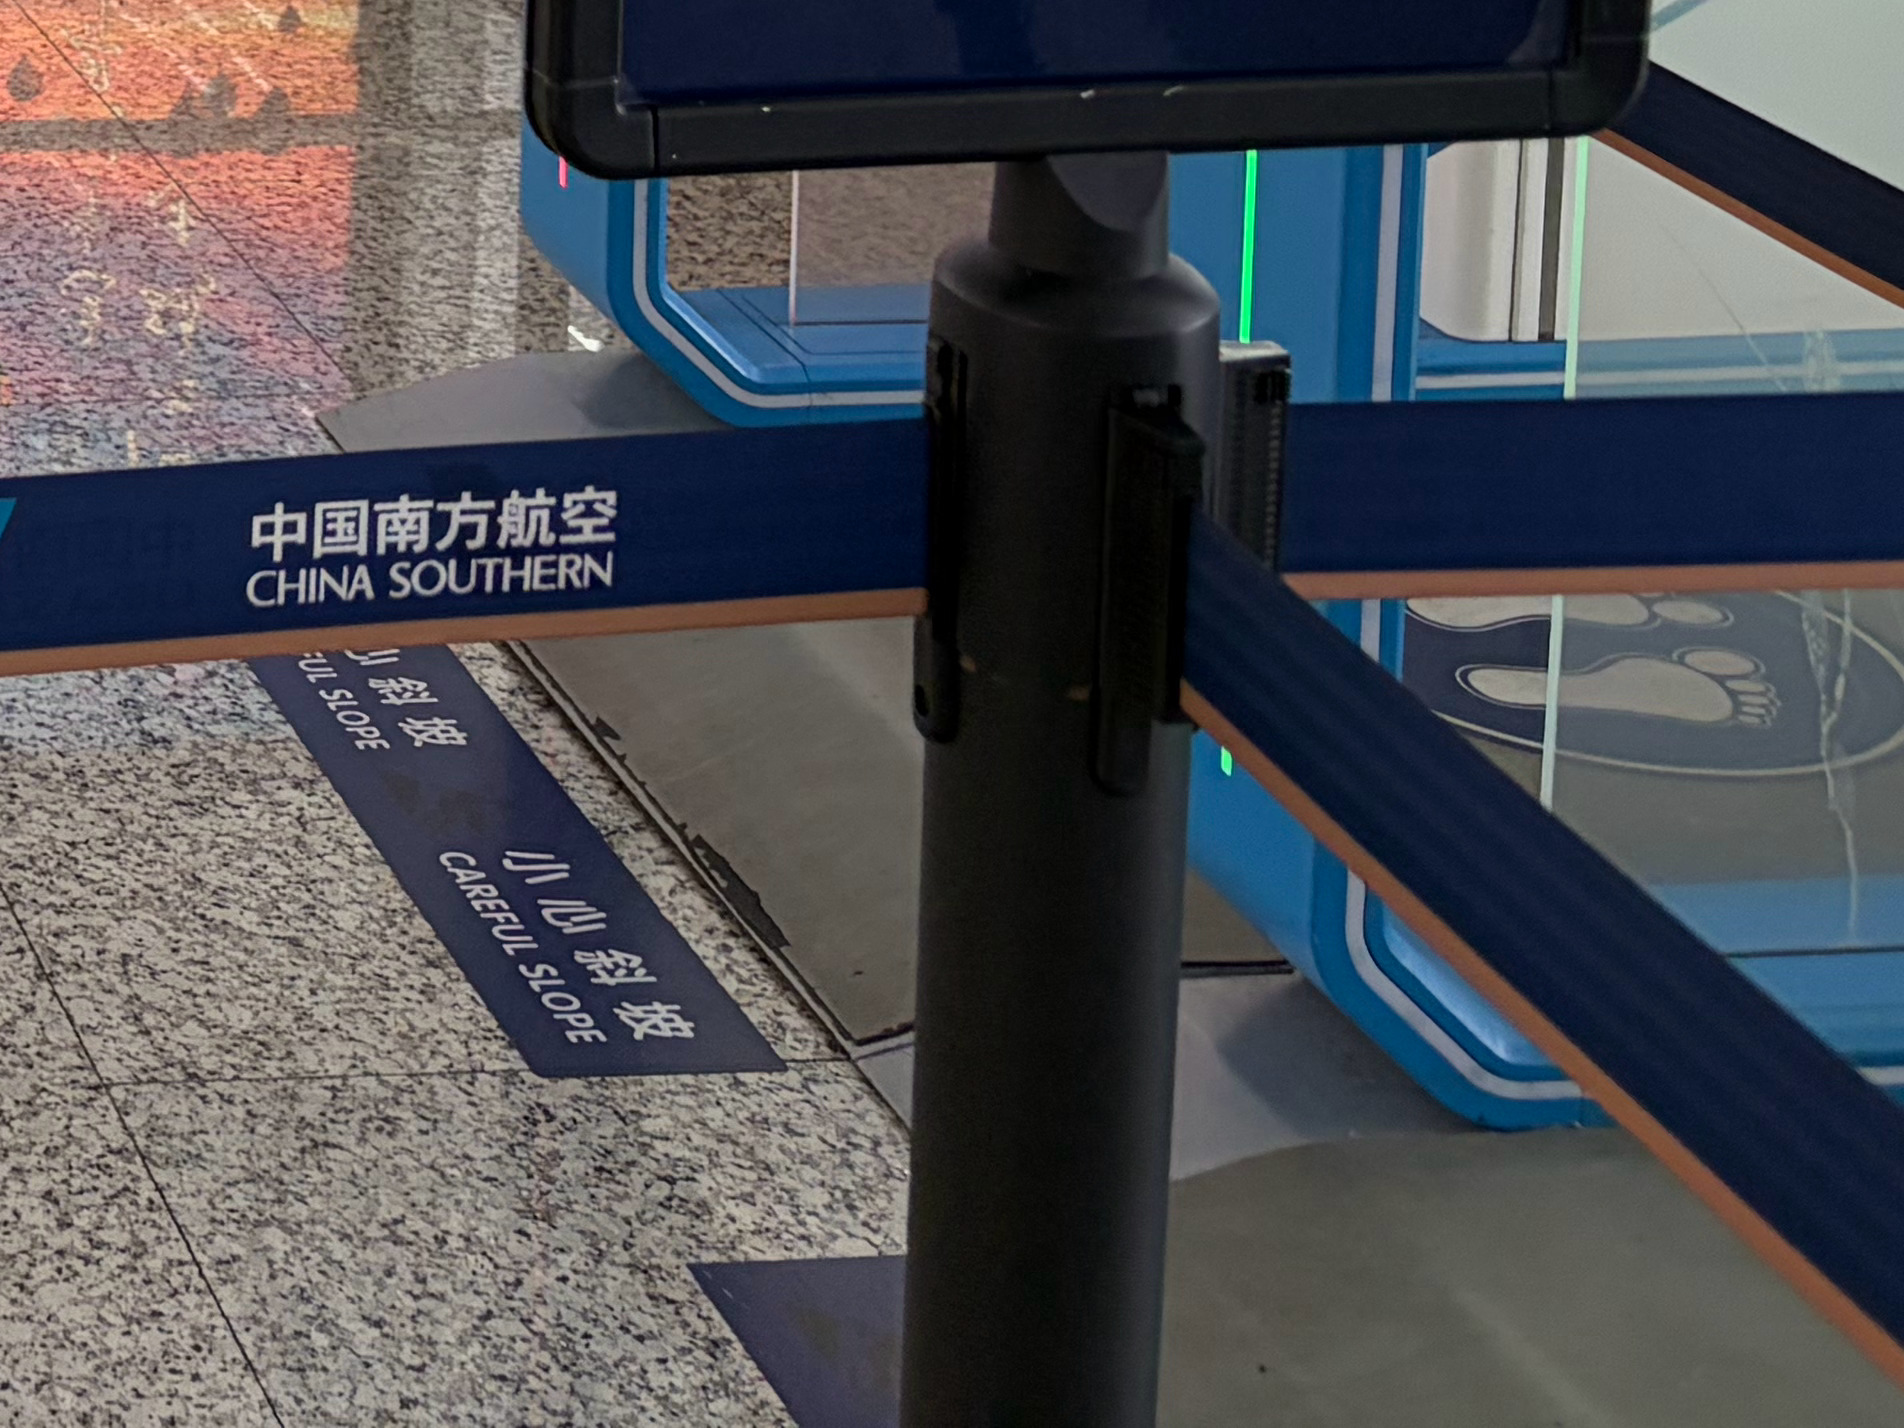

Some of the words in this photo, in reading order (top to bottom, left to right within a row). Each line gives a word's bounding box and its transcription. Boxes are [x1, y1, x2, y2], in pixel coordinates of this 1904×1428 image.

[249, 485, 620, 563] 中国南方航空
[245, 562, 375, 610] CHINA
[388, 550, 616, 599] SOUTHERN
[318, 688, 392, 751] SLOPE
[438, 850, 538, 957] CAREFUL
[518, 962, 608, 1047] SLOPE
[501, 848, 697, 1044] 小心斜坡
